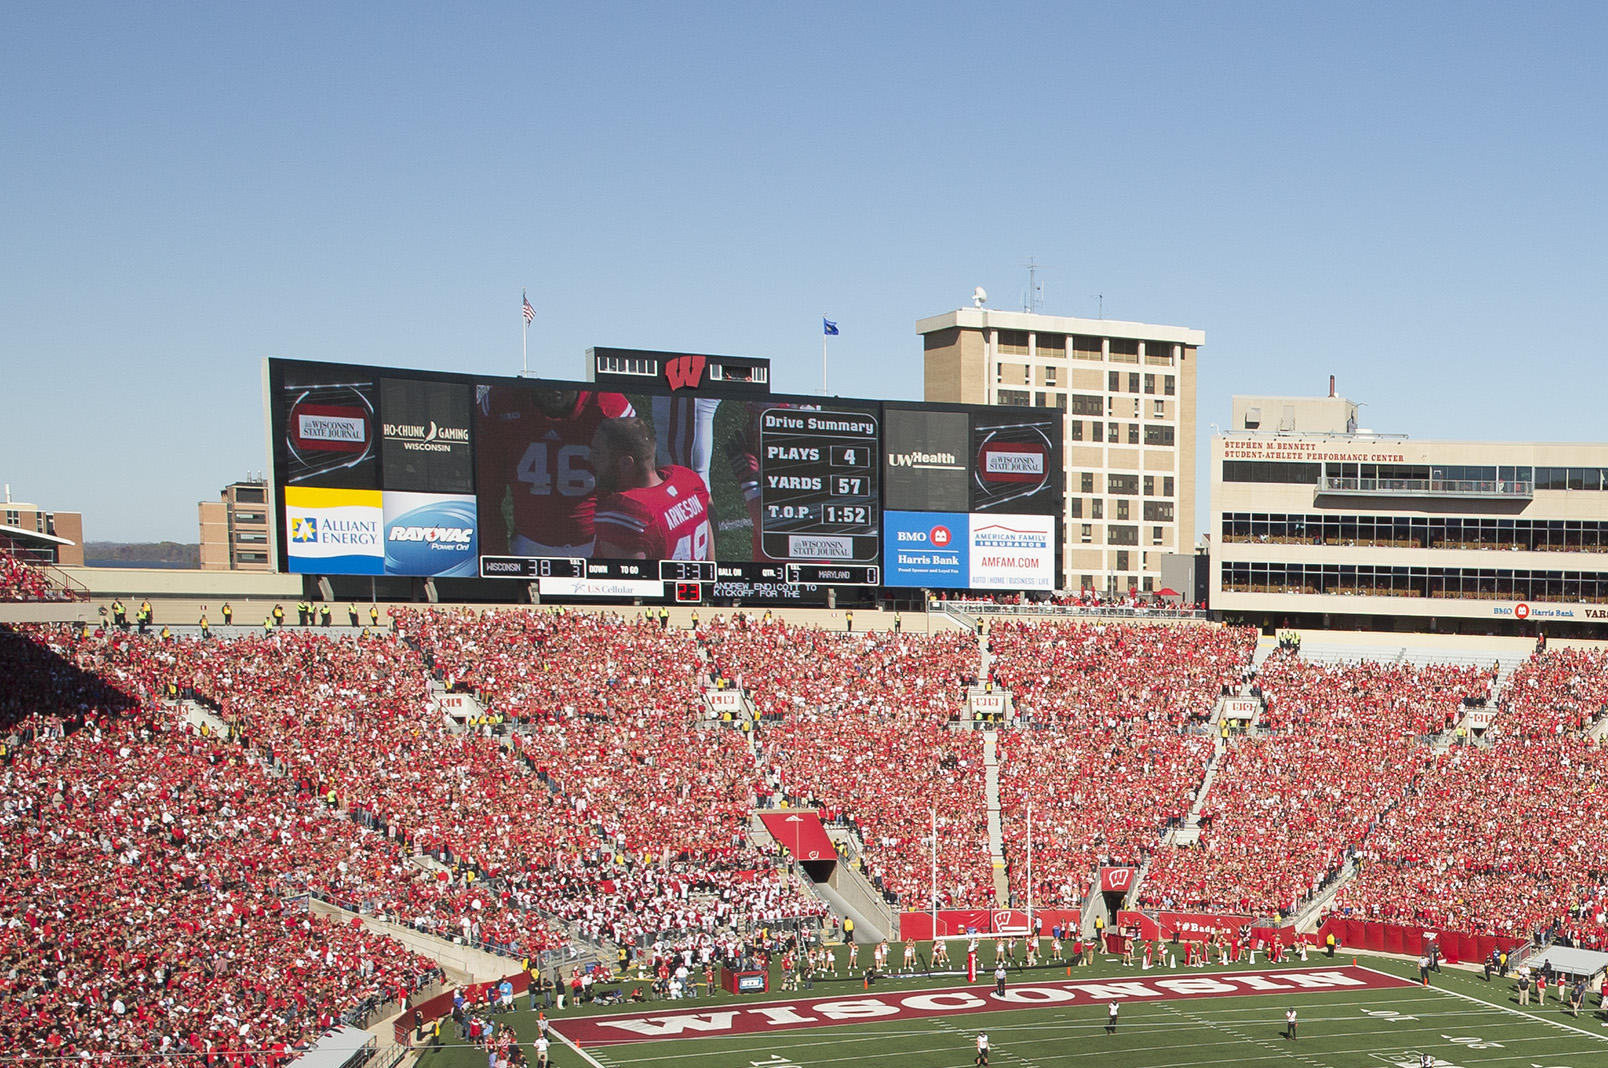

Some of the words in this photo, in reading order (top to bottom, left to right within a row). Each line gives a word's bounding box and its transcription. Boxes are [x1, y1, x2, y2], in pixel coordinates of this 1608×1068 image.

[765, 415, 805, 429] Drive
[808, 418, 874, 434] Summary
[384, 424, 424, 438] HO-CHUNK
[438, 429, 469, 440] GAMING
[404, 442, 451, 452] WISCONSIN
[1224, 441, 1263, 450] STEPHEN
[1277, 443, 1316, 451] BENNETT
[767, 446, 820, 461] PLAYS
[844, 449, 856, 465] 4
[1224, 451, 1303, 460] STUDENT-ATHLETE
[1307, 452, 1368, 461] PERFORMANCE
[1371, 454, 1404, 462] CENTER
[516, 442, 596, 496] 46
[768, 475, 822, 490] YARDS
[838, 478, 861, 494] 57
[664, 495, 704, 531] ARNESON
[768, 505, 814, 519] T.O.P.
[827, 506, 866, 523] 1:52
[322, 518, 377, 532] ALLIANT
[322, 533, 377, 544] ENERGY
[388, 526, 474, 543] RAYOVAC
[897, 531, 927, 542] BMO
[431, 542, 456, 550] Power
[898, 555, 931, 565] Harris
[933, 556, 960, 566] Bank
[981, 557, 1040, 569] AMFAM.COM
[486, 562, 521, 572] WISCONSIN
[528, 560, 551, 577] 38
[573, 566, 580, 578] 3
[718, 567, 733, 577] BALL
[733, 568, 742, 577] ON
[777, 567, 784, 579] 3
[818, 570, 850, 579] MARYLAND
[866, 568, 876, 583] 0
[678, 584, 699, 600] 23
[713, 583, 749, 591] ANDREW
[753, 584, 800, 592] ENDICOTT
[805, 584, 817, 592] TO
[713, 589, 754, 598] KICKOFF
[759, 590, 778, 598] FOR
[782, 590, 801, 598] THE
[1531, 609, 1554, 617] Harris
[596, 971, 1366, 1036] WISCONSIN
